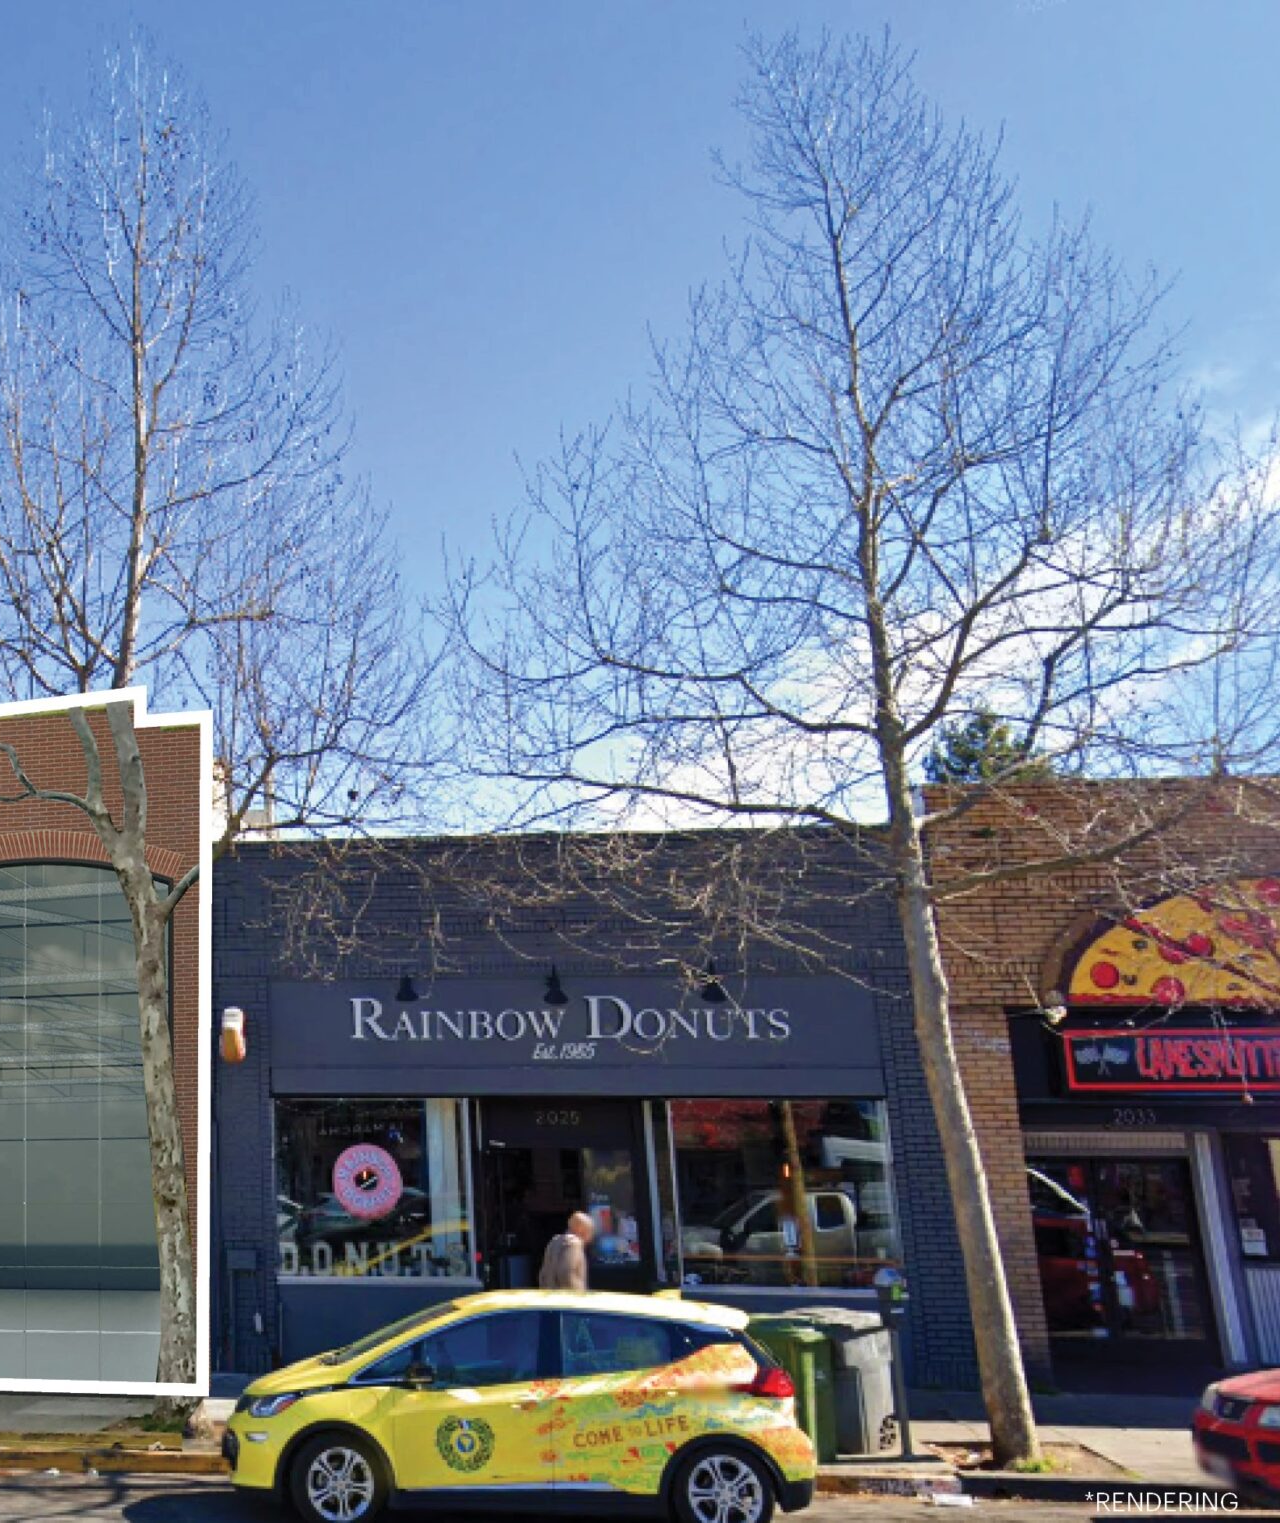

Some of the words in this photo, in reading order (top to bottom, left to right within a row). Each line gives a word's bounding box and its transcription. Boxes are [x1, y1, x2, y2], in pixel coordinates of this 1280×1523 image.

[350, 998, 566, 1041] RAINBOW
[584, 995, 790, 1041] DONUTS
[535, 1110, 580, 1125] 2025
[1113, 1108, 1156, 1125] 2033
[573, 1425, 624, 1447] COME
[644, 1415, 689, 1437] LIFE
